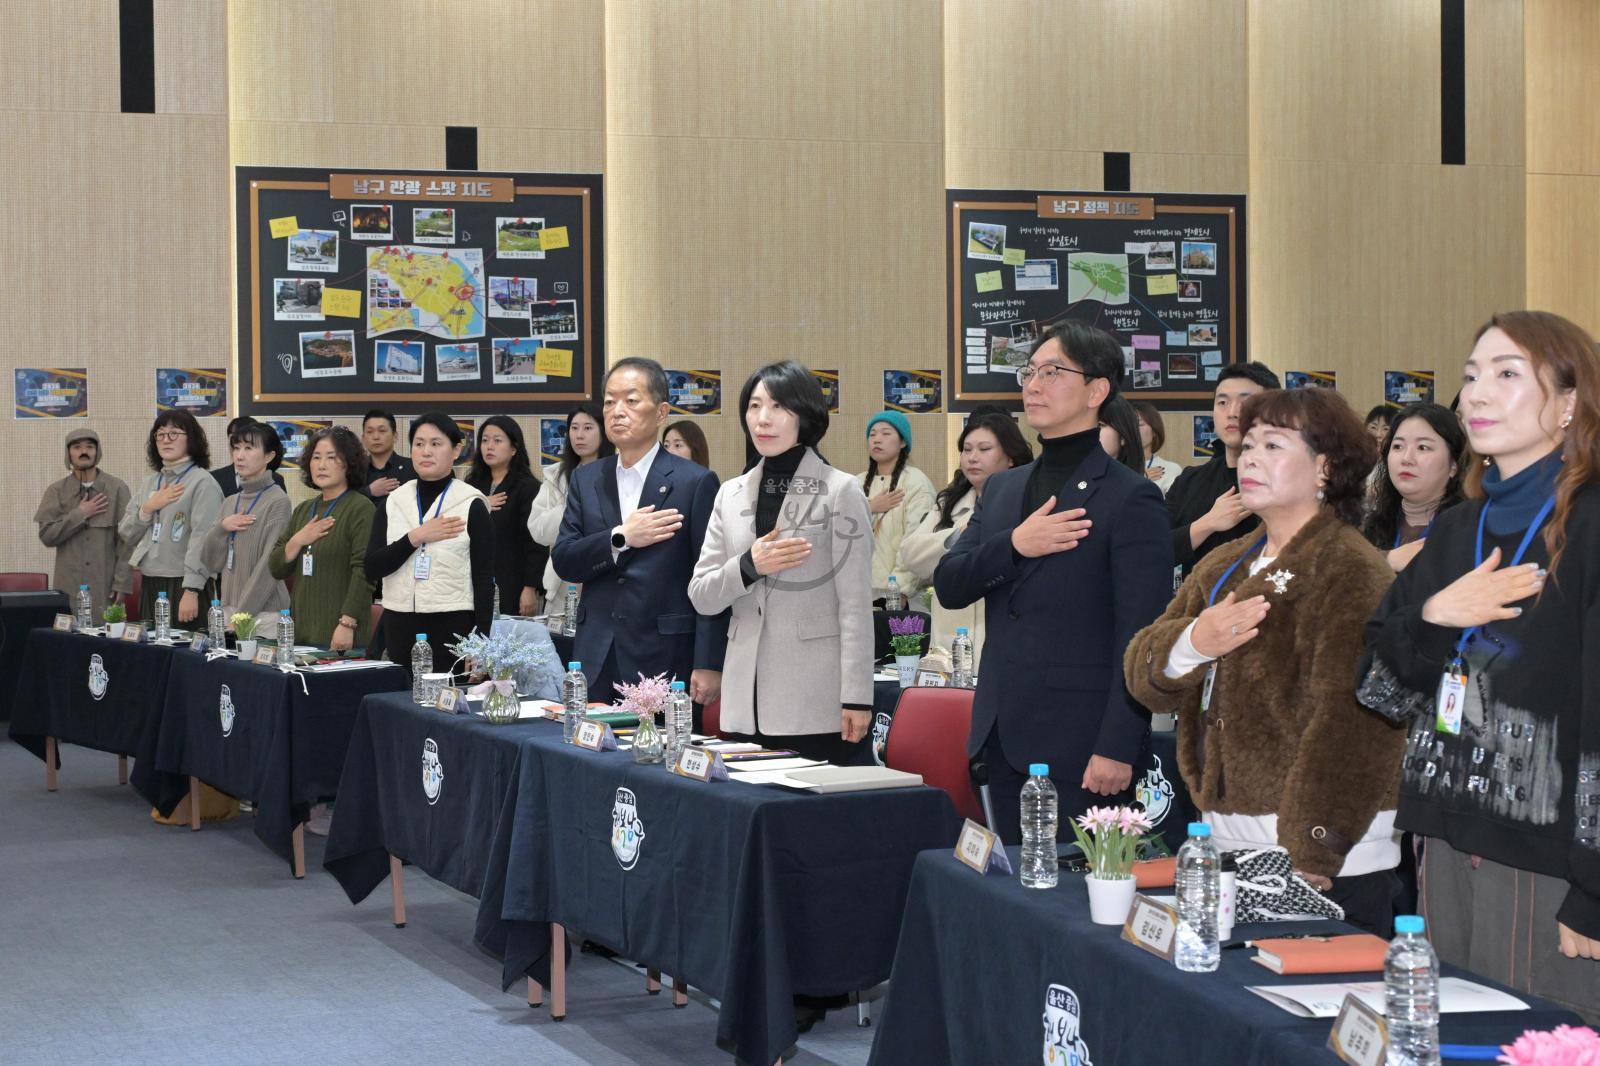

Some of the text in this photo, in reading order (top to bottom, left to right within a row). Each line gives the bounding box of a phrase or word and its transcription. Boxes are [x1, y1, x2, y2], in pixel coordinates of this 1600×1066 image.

[353, 178, 497, 198] 남구 관광 스팟 지도
[1053, 199, 1141, 216] 남구 정책 지도
[1183, 227, 1210, 238] 경제도시
[1047, 234, 1079, 248] 안심도시
[980, 308, 1019, 322] 문화관광도시
[1195, 309, 1219, 320] 명품도시
[1113, 317, 1139, 329] 행복도시
